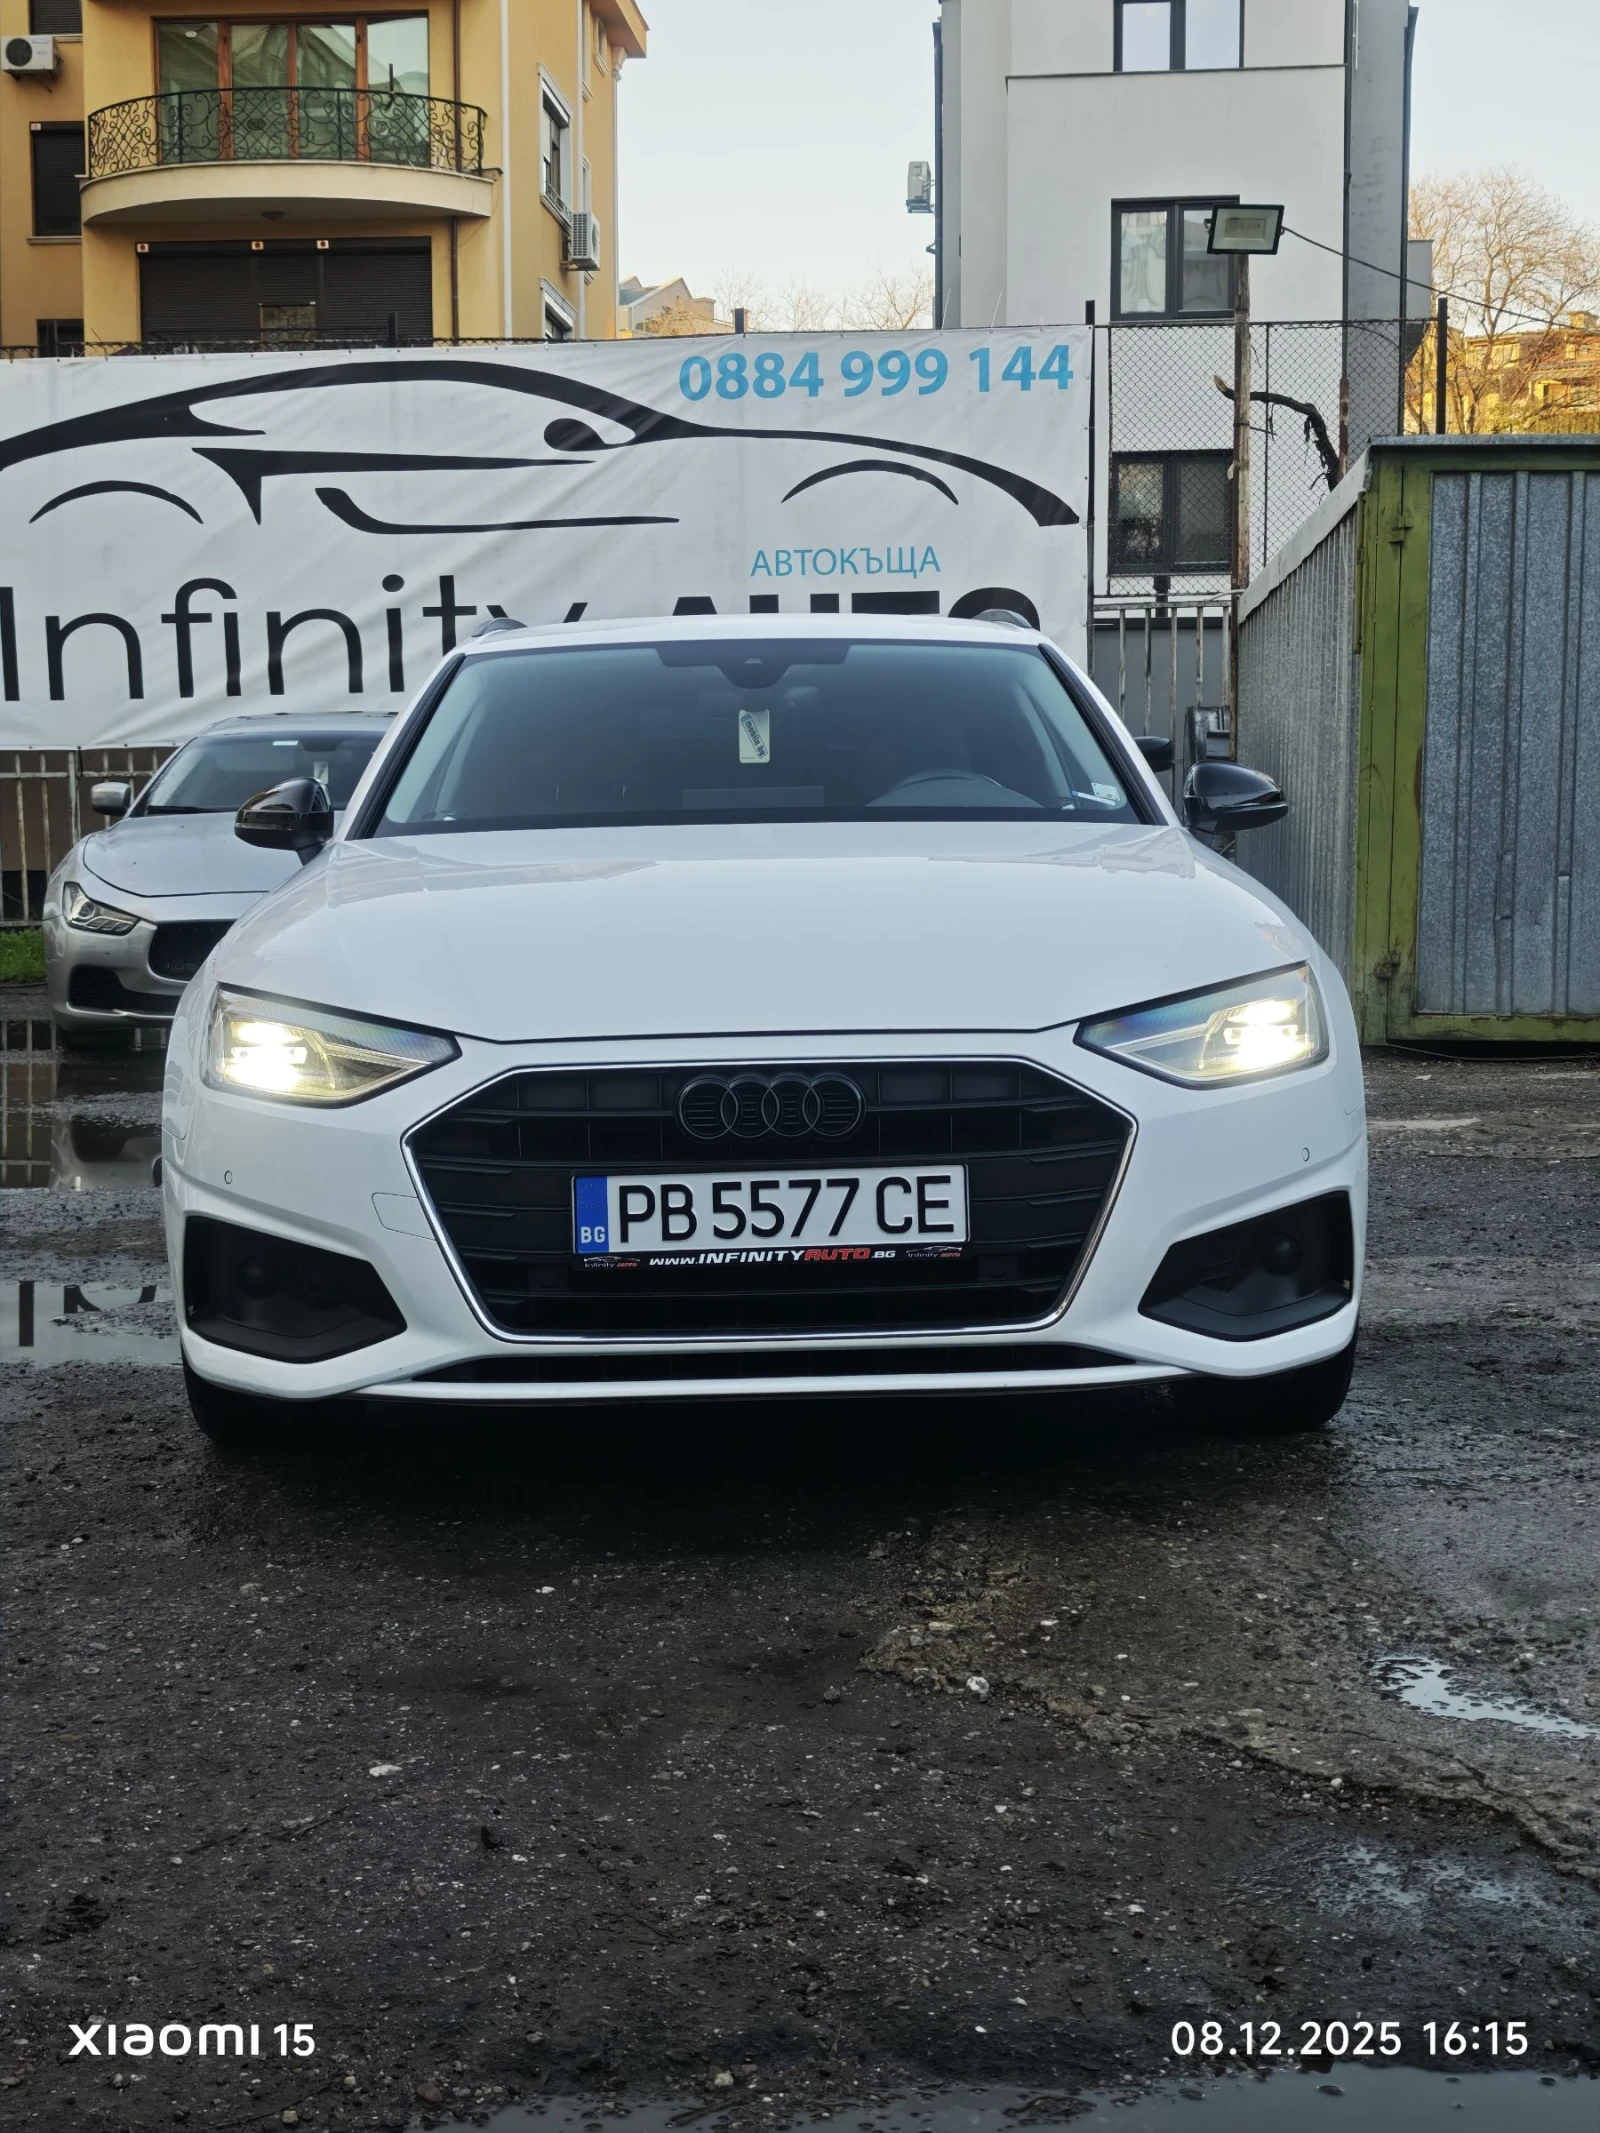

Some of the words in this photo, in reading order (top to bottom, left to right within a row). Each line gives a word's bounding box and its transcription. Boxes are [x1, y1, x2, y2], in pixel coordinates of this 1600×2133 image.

[680, 352, 824, 401] 0884
[840, 349, 949, 397] 999
[969, 344, 1074, 393] 144
[750, 546, 941, 579] АВТОКЪЩА
[0, 574, 588, 702] Infinit
[580, 1226, 606, 1244] BG
[618, 1184, 698, 1243] PB
[712, 1178, 860, 1239] 5577
[876, 1176, 955, 1234] CE
